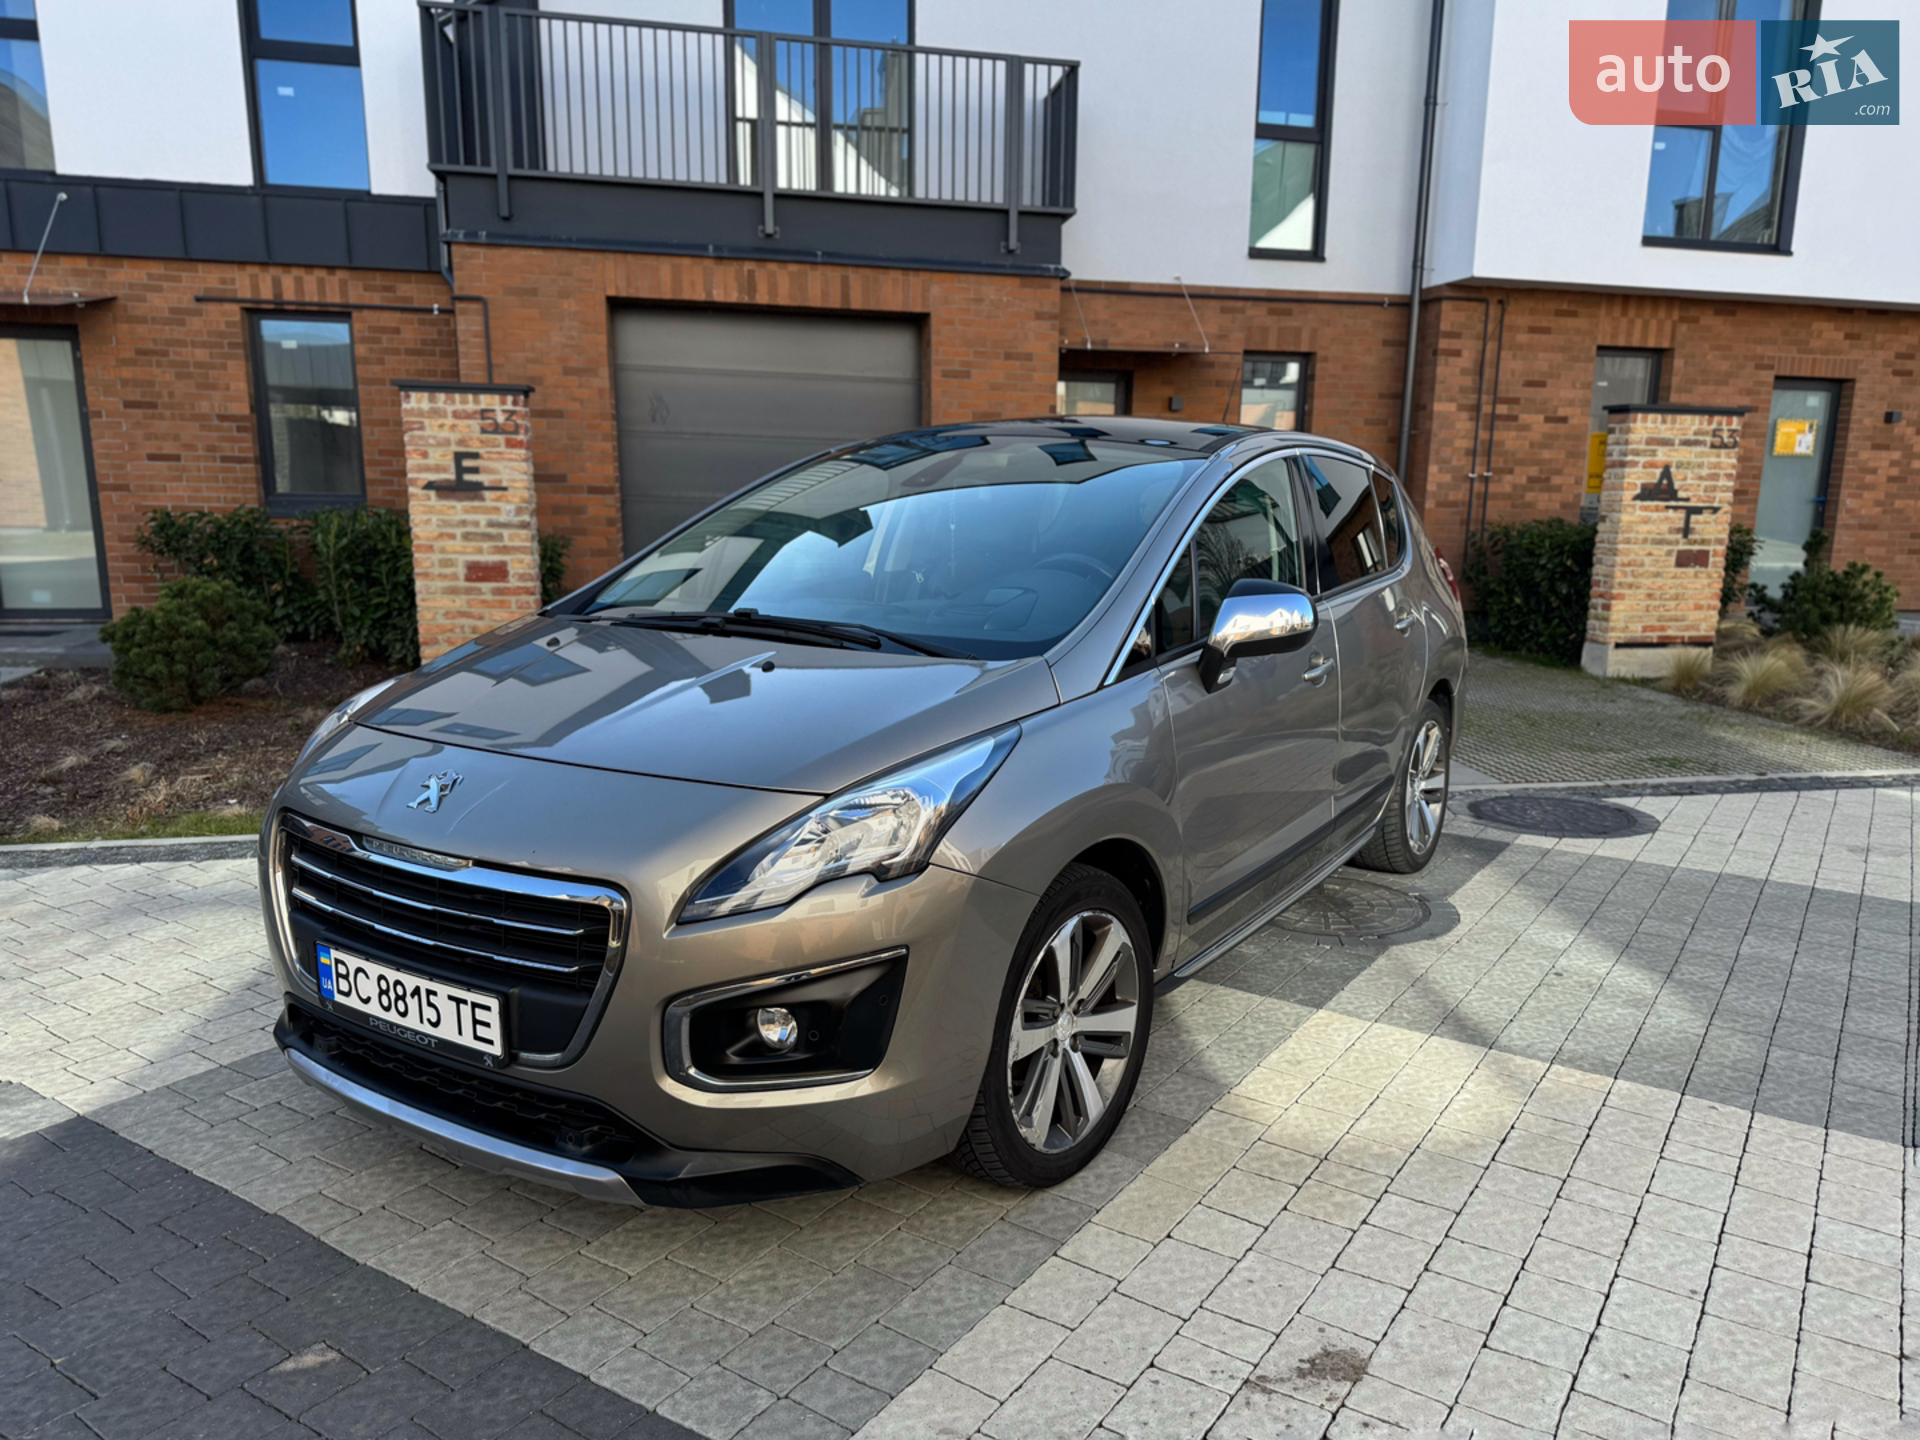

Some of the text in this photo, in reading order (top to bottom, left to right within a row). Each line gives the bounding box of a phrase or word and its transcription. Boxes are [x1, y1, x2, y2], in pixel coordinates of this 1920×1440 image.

[480, 408, 519, 435] 53
[1710, 429, 1739, 449] 53
[321, 976, 333, 991] UA
[333, 957, 495, 1046] BC 8815 TE
[369, 1016, 439, 1048] PEUGEOT
